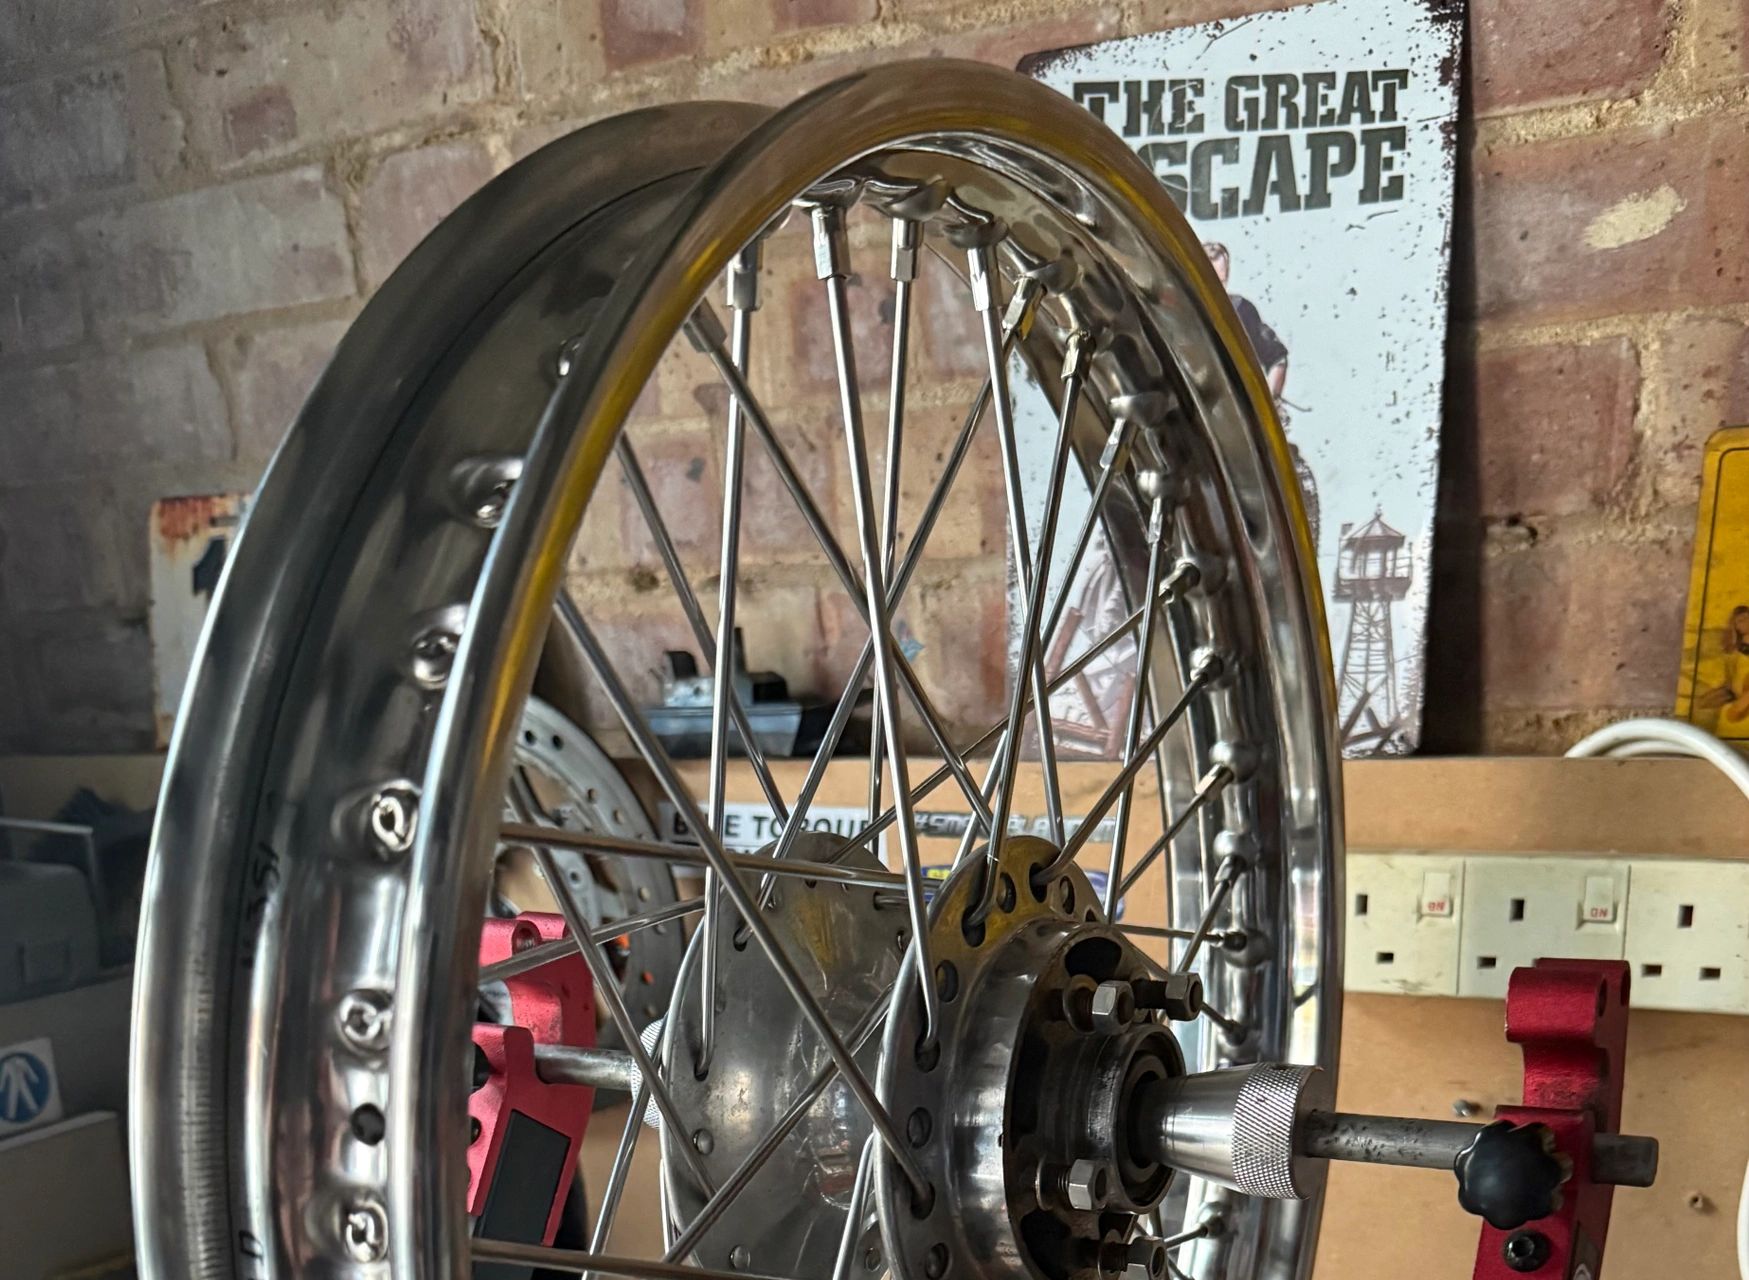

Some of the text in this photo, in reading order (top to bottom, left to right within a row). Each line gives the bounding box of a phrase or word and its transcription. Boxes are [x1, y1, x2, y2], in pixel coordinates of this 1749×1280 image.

[1073, 69, 1409, 138] THE GREAT
[1137, 126, 1407, 221] SCAPE
